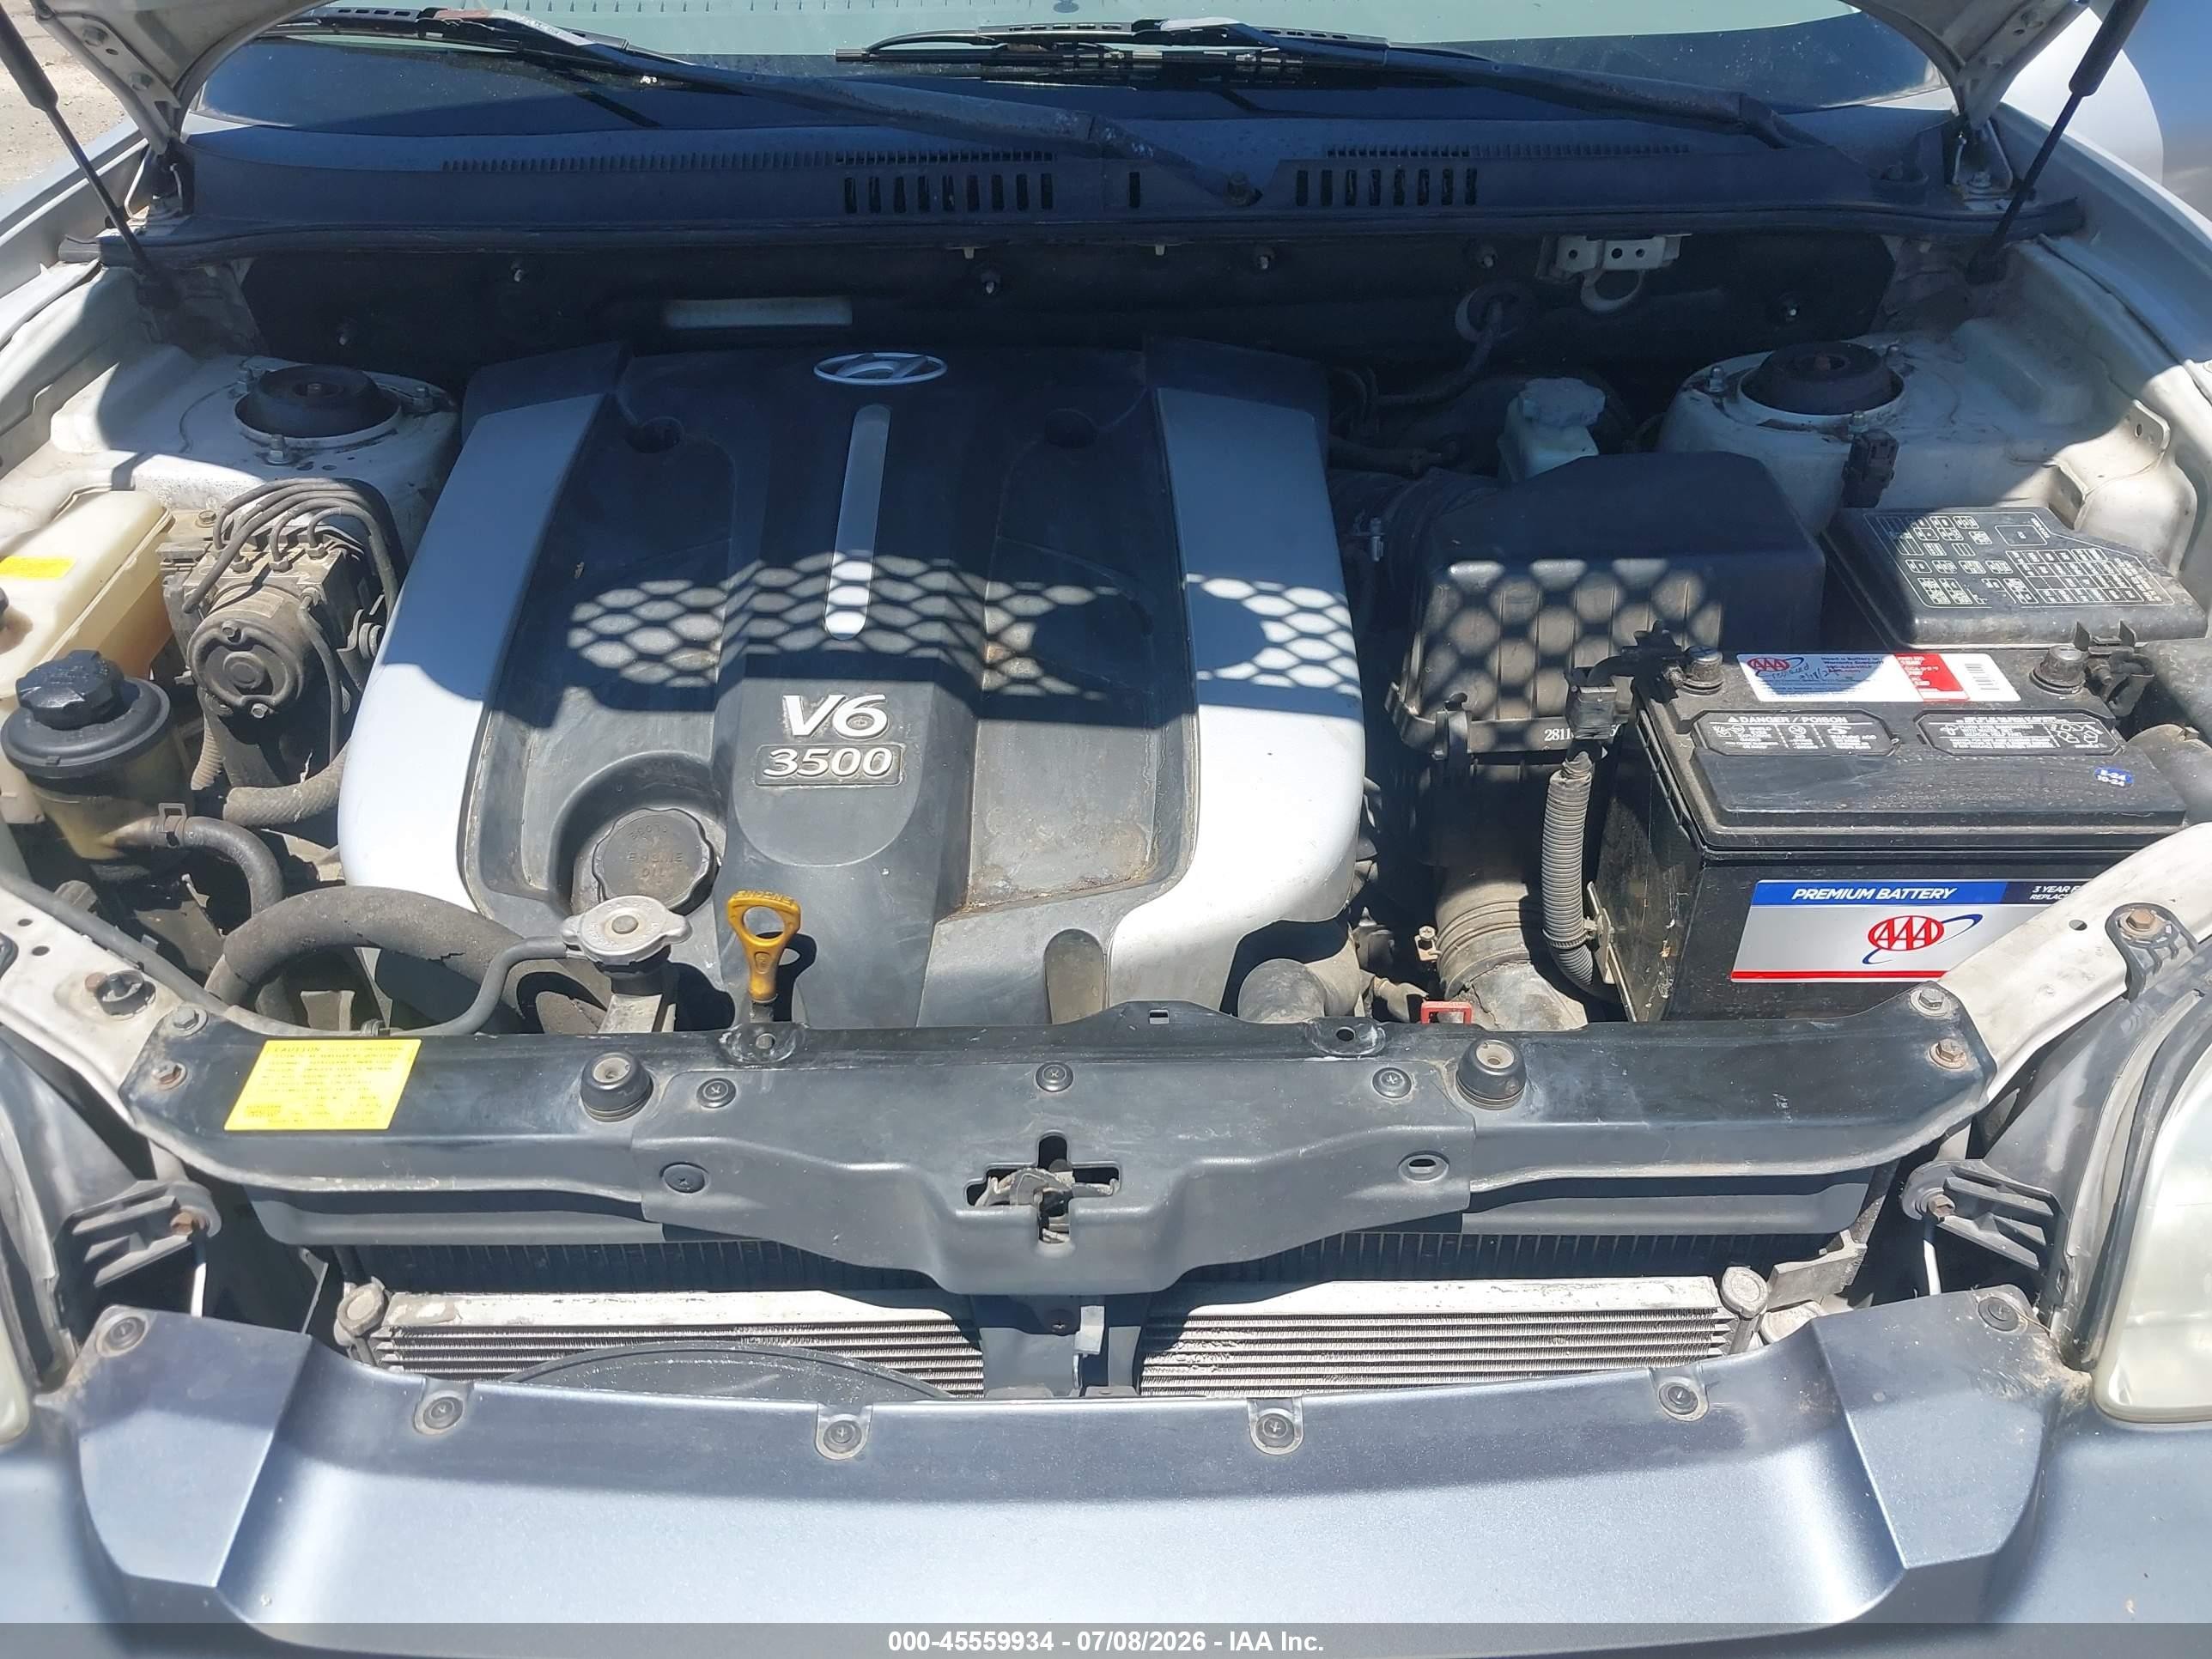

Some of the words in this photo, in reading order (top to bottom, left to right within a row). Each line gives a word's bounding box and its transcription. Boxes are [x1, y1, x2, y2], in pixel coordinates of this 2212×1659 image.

[1749, 658, 1788, 671] AAA
[781, 694, 890, 738] V6
[1544, 727, 1574, 742] 2811
[762, 746, 894, 778] 3500
[2097, 775, 2125, 787] 10-24
[1791, 888, 1880, 900] PREMIUM
[1875, 887, 1958, 900] BATTERY
[1871, 916, 1942, 951] AAA
